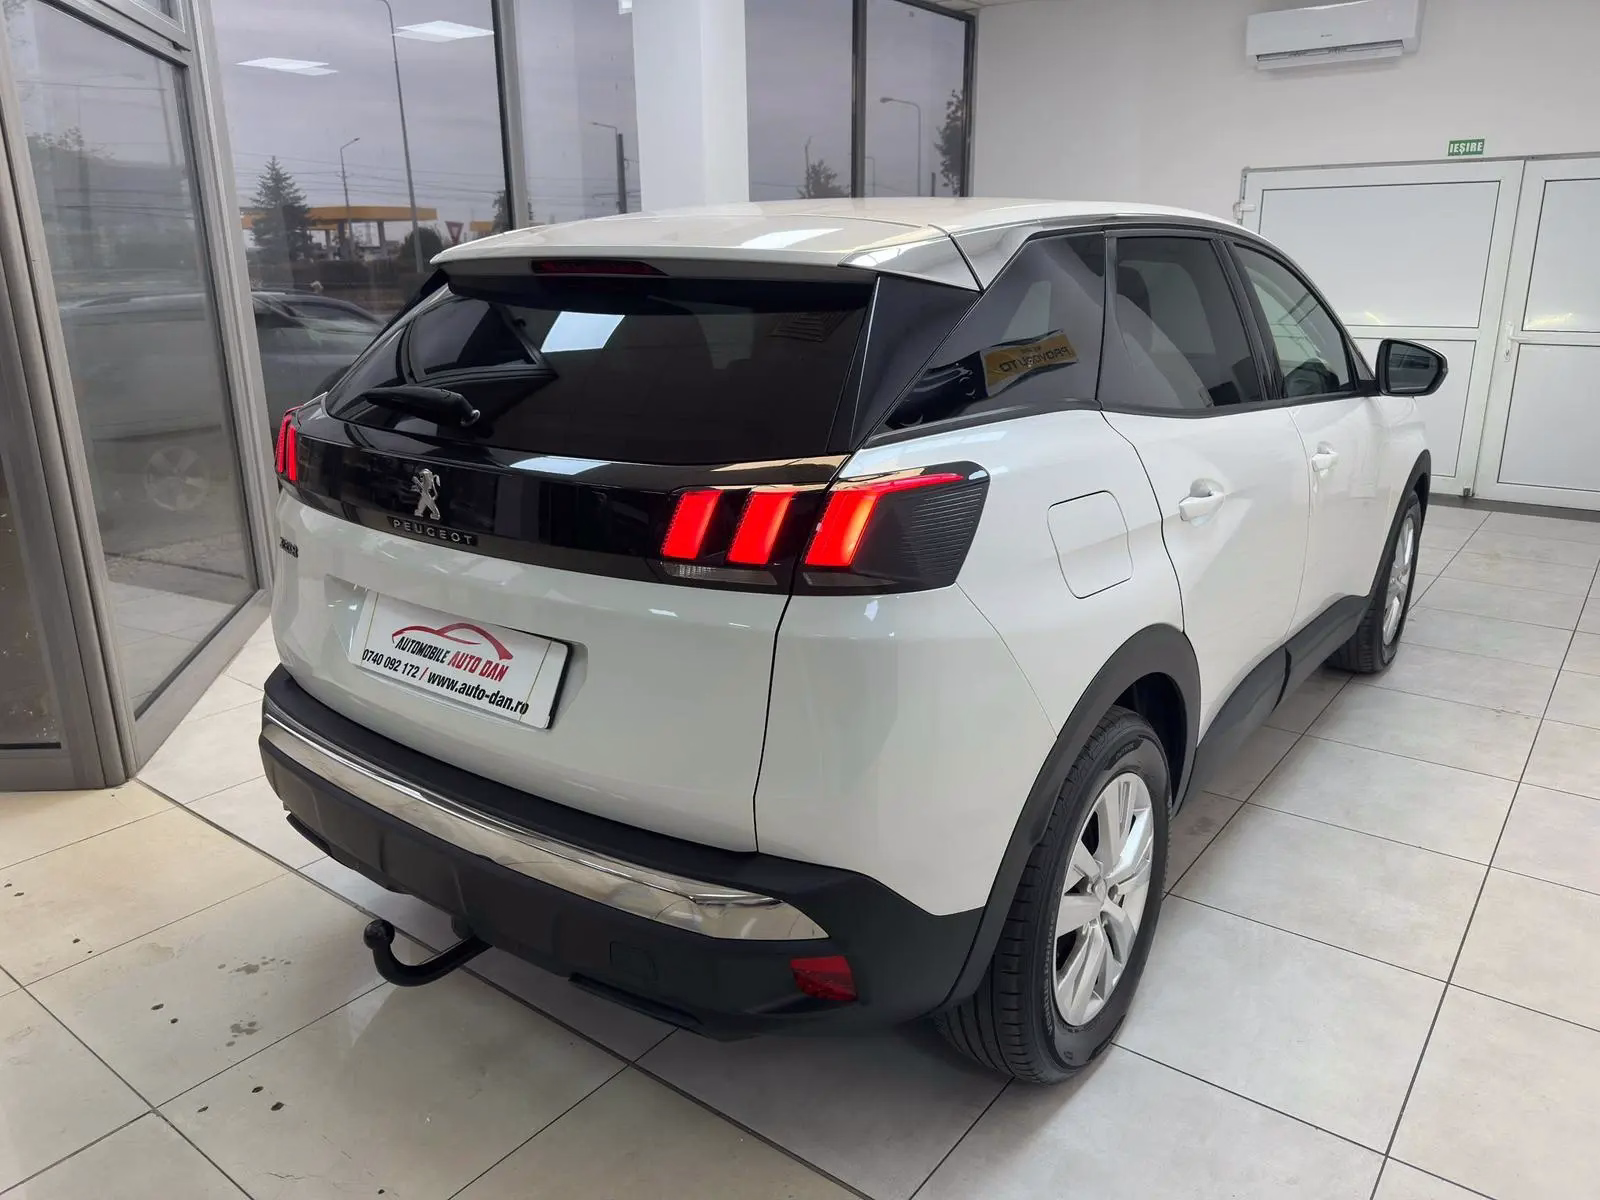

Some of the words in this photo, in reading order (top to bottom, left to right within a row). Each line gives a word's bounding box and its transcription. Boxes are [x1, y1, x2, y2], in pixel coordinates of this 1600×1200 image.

[392, 519, 473, 545] PEUGEOT
[362, 648, 383, 666] 0740
[383, 655, 399, 672] 092
[401, 662, 420, 679] 172
[418, 667, 430, 681] /
[427, 671, 530, 716] www.auto-dan.ro
[395, 636, 451, 664] AUTOMOBILE
[448, 651, 482, 674] AUTO
[479, 662, 509, 683] DAN
